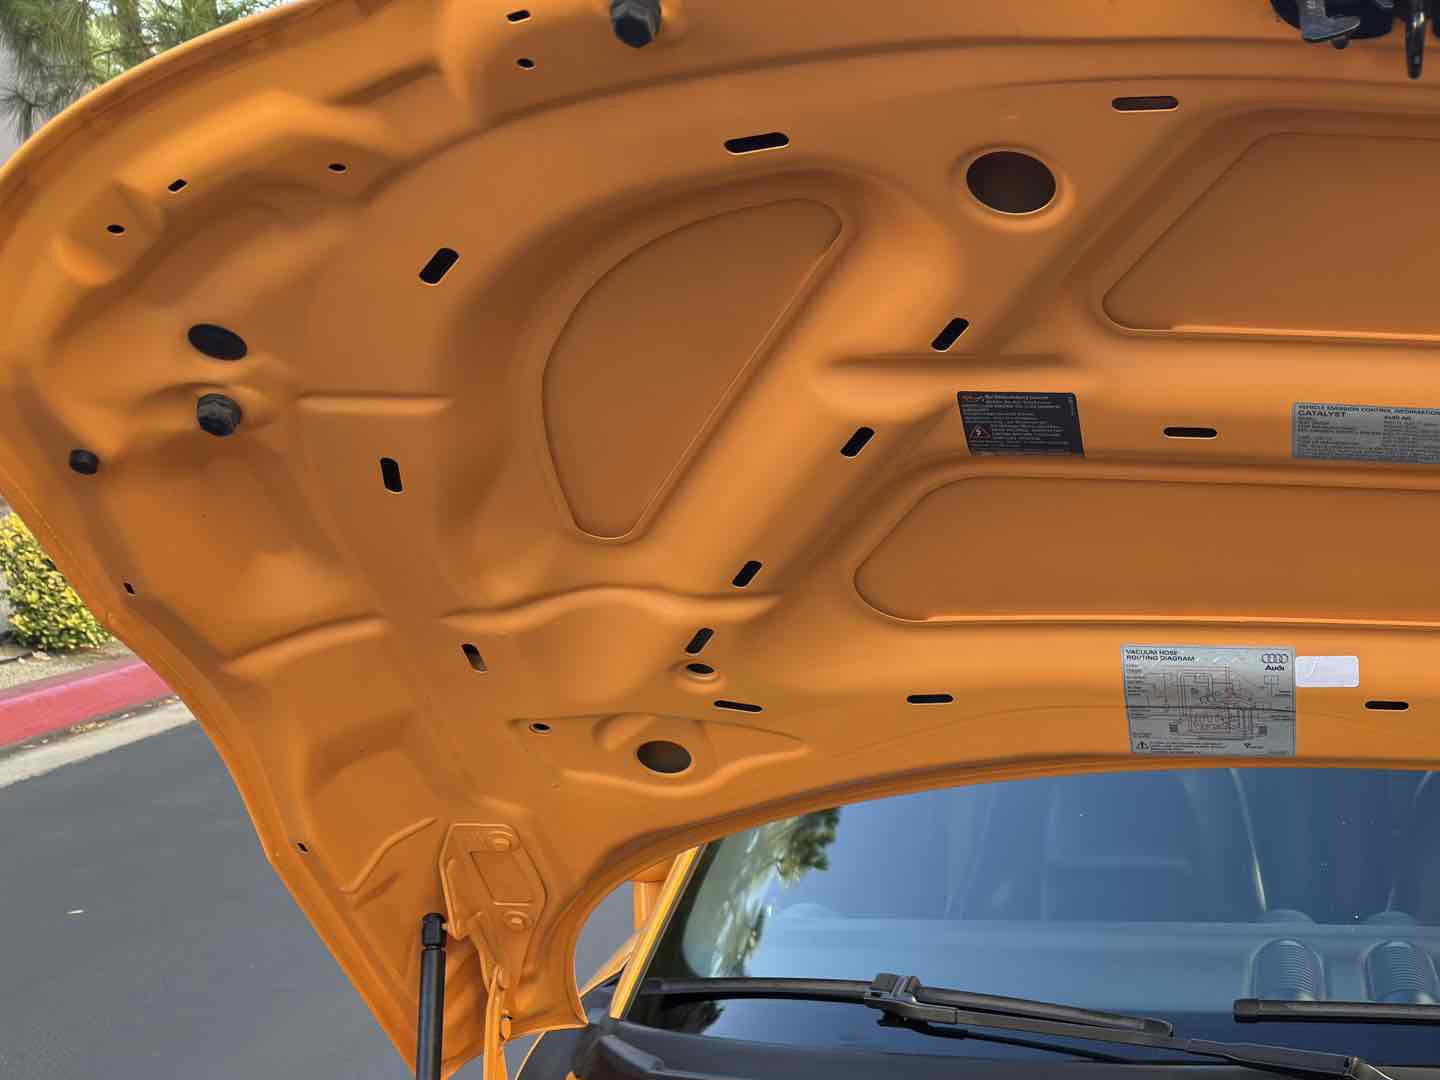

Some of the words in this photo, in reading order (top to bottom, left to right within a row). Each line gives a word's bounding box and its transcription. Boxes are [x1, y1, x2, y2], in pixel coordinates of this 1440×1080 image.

[1297, 410, 1346, 418] CATALYST
[1126, 648, 1158, 656] VACUUM
[1126, 654, 1159, 662] ROUTING
